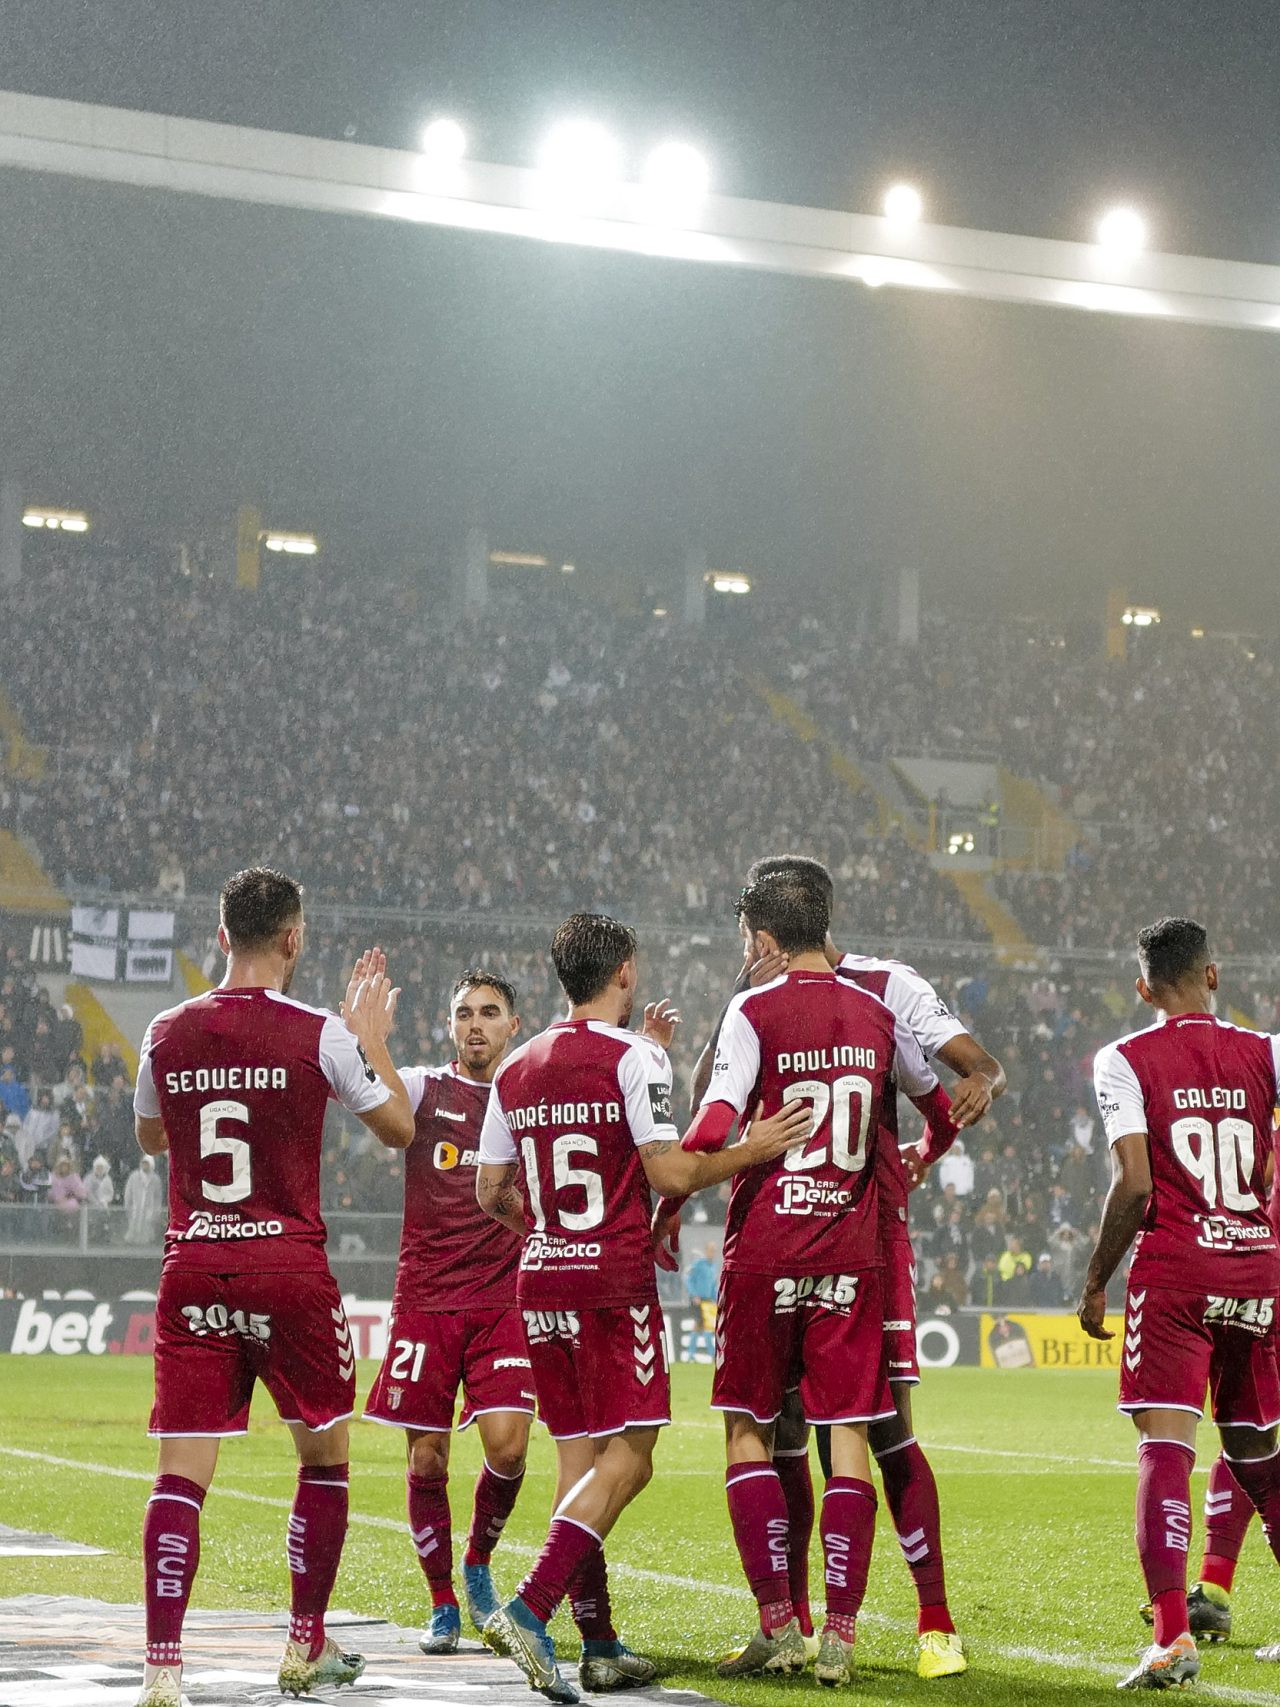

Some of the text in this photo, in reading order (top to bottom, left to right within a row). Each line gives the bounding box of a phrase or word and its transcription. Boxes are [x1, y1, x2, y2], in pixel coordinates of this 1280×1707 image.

[166, 1067, 287, 1094] SEQUEIRA
[778, 1045, 876, 1074] PAULINHO
[783, 1075, 872, 1172] 20
[200, 1100, 252, 1203] 5
[1171, 1117, 1261, 1211] 90
[521, 1133, 605, 1231] 15
[214, 1213, 241, 1222] CASA
[774, 1274, 859, 1305] 2045
[1203, 1295, 1276, 1326] 2045
[390, 1340, 426, 1382] 21
[766, 1518, 791, 1572] SCB
[1162, 1499, 1191, 1552] SCB
[156, 1533, 189, 1598] SCB
[825, 1533, 851, 1588] SCB
